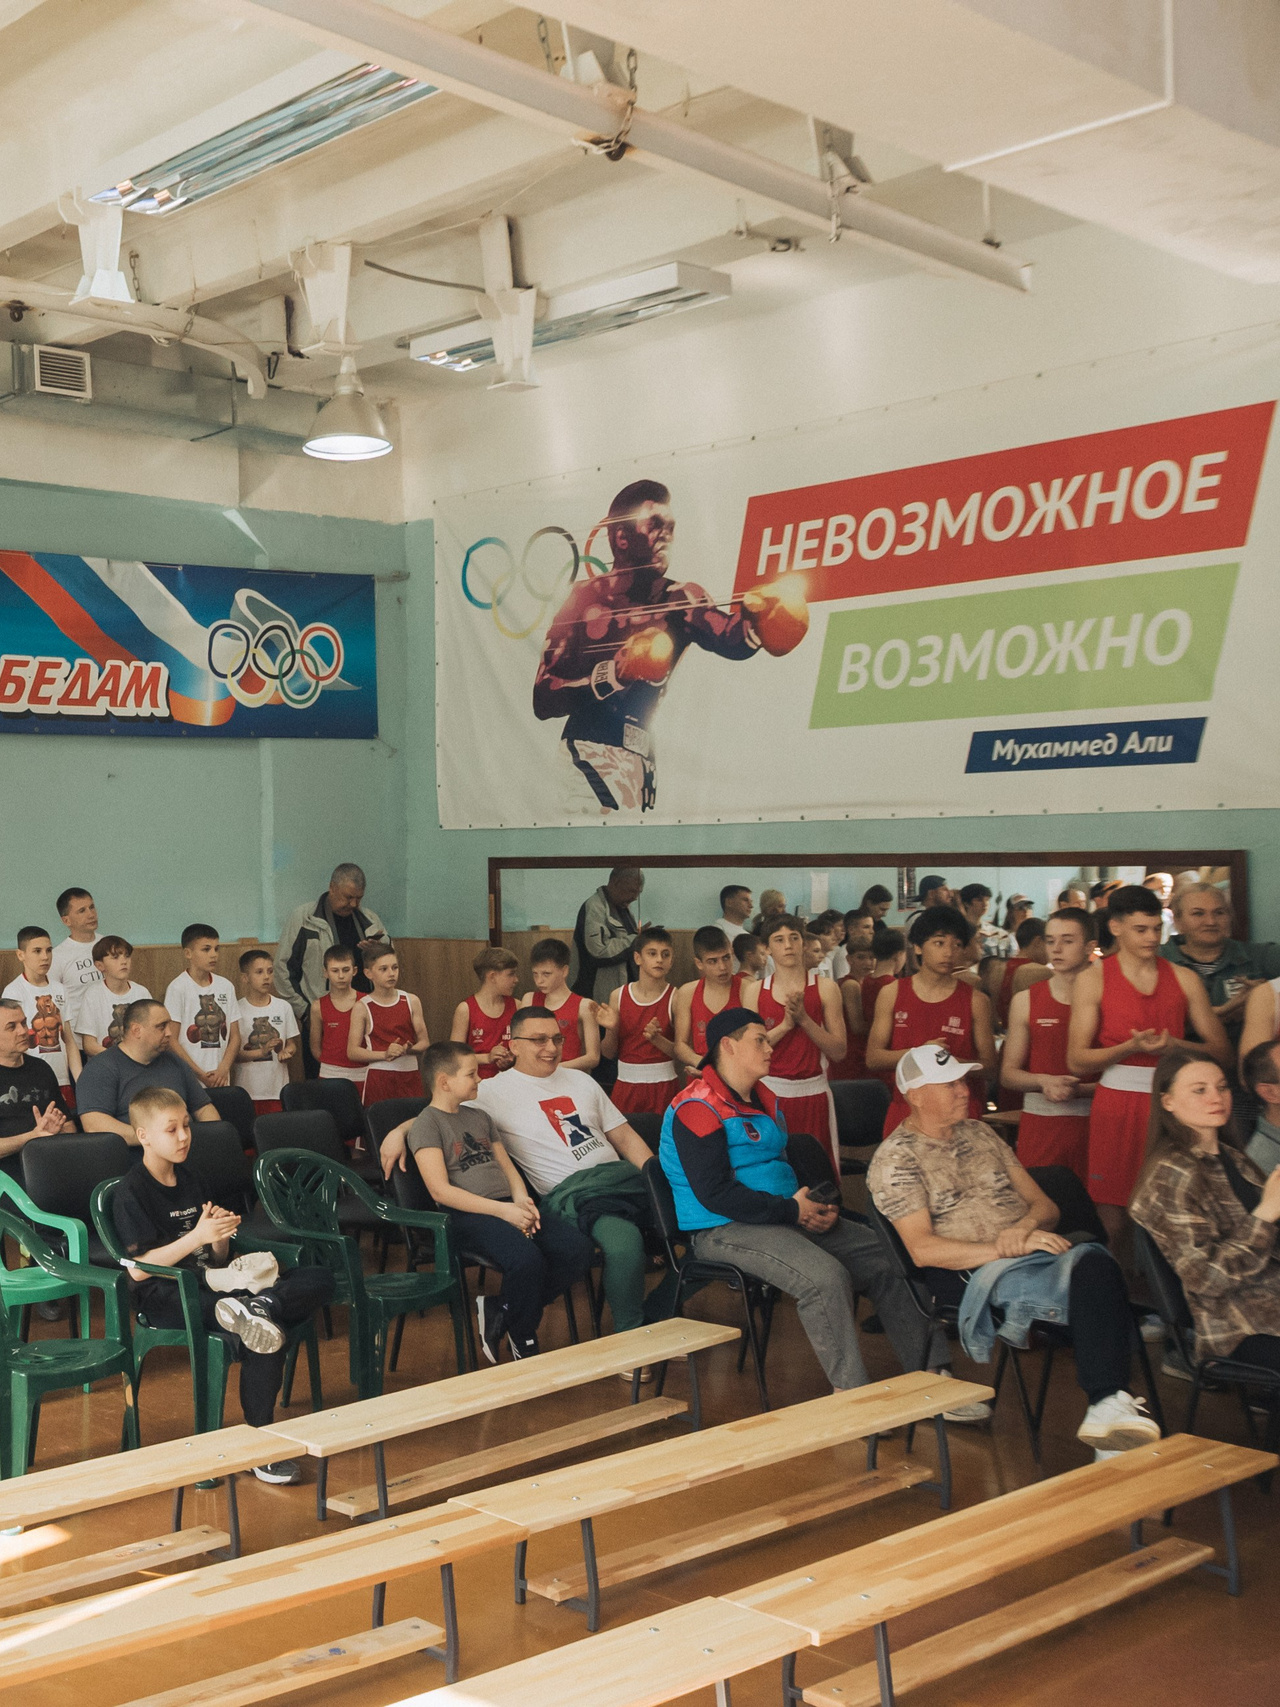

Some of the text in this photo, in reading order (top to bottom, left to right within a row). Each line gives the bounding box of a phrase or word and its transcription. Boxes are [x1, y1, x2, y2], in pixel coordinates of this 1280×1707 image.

[756, 451, 1227, 576] НЕВОЗМОЖНОЕ
[837, 608, 1194, 694] ВОЗМОЖНО
[992, 731, 1173, 765] Мухаммед Али
[75, 958, 93, 971] БО
[571, 1138, 606, 1162] BOXING
